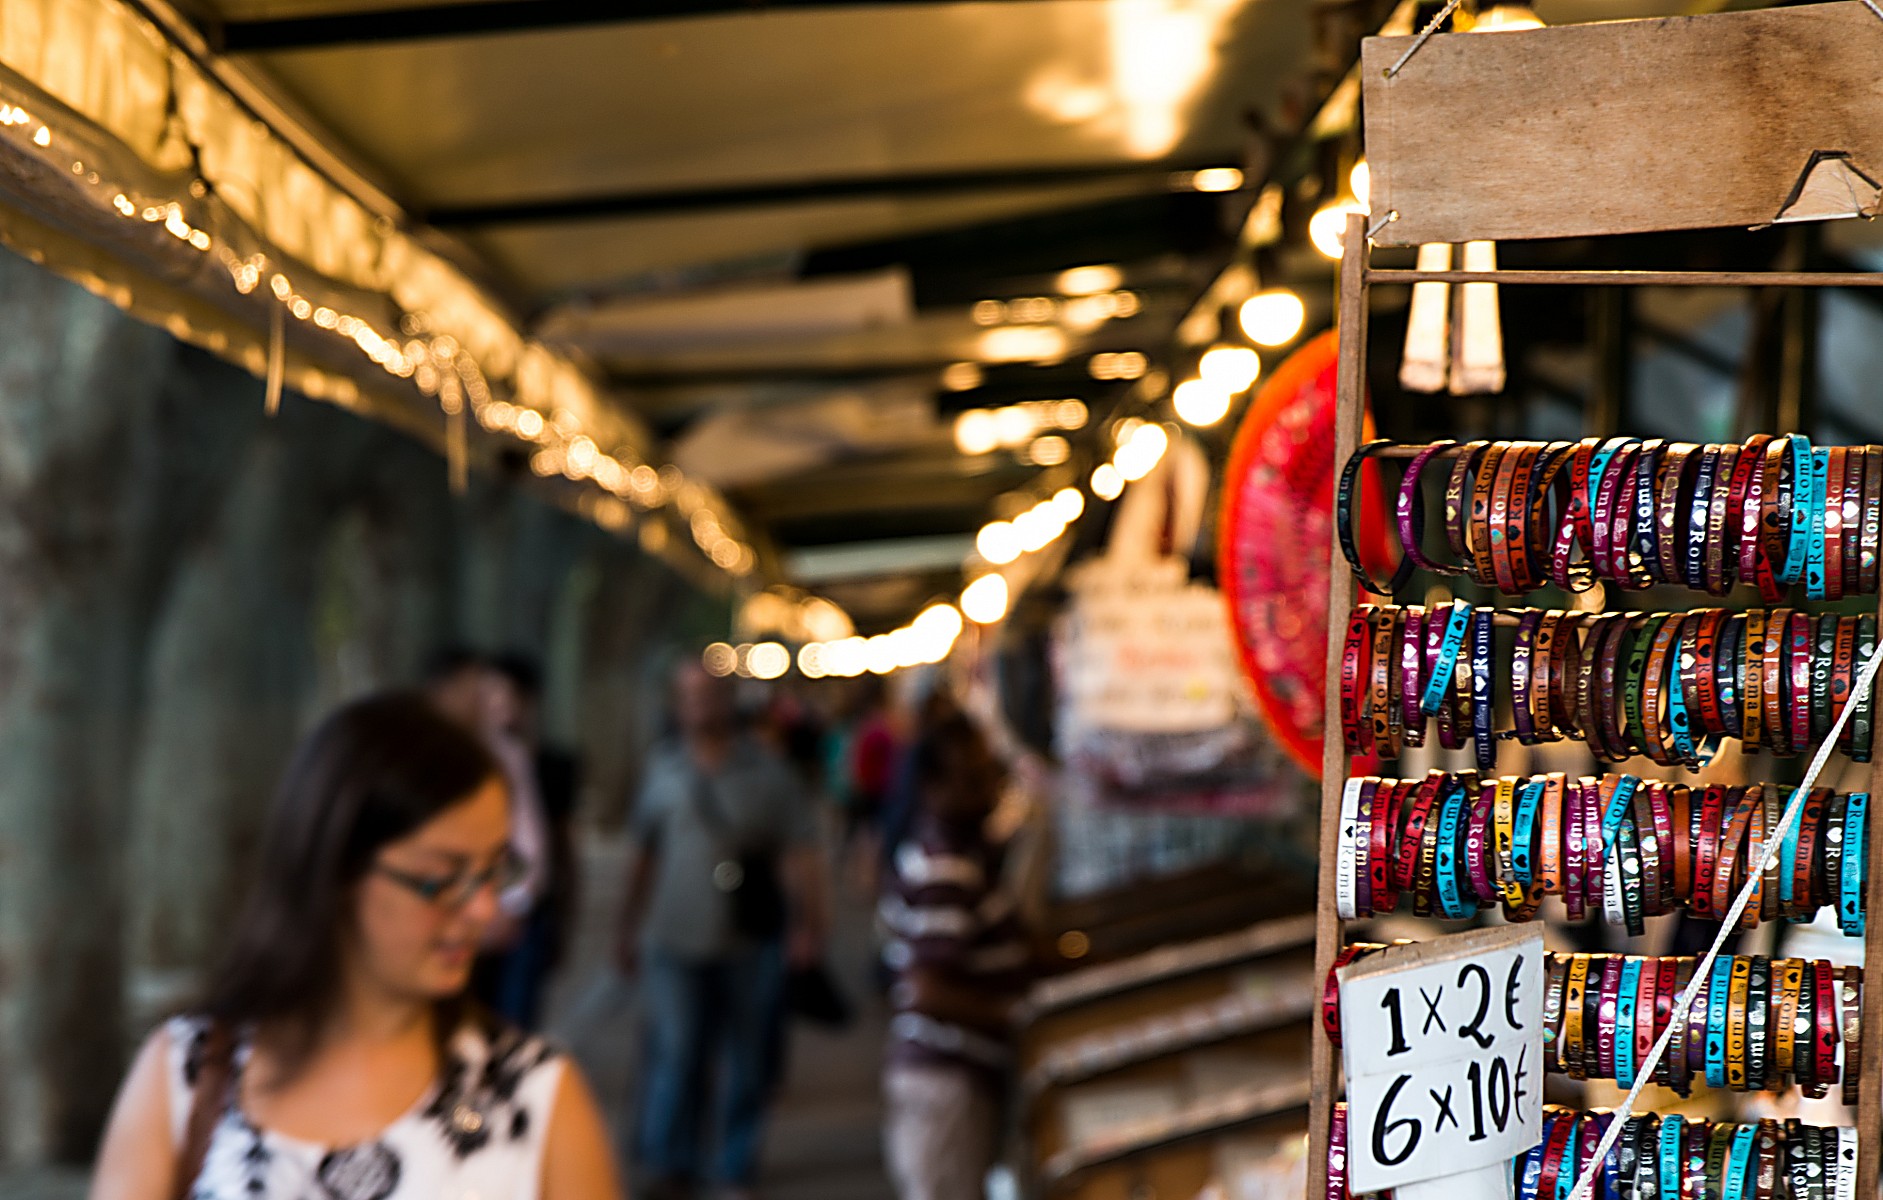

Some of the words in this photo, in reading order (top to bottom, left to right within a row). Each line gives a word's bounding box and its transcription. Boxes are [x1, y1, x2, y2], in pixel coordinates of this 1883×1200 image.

[1509, 472, 1527, 522] Roma
[1638, 476, 1650, 533] Roma
[1796, 454, 1809, 505] Roma
[1709, 486, 1730, 546] Roma
[1808, 508, 1824, 566] Roma
[1433, 635, 1463, 688] Roma
[1474, 619, 1489, 670] Roma
[1834, 629, 1852, 674] Roma
[1373, 659, 1388, 714] Roma
[1512, 646, 1530, 703] Roma
[1698, 663, 1712, 714] Roma
[1747, 659, 1763, 711] Roma
[1813, 657, 1831, 708] Roma
[1538, 684, 1549, 737] Roma
[1439, 797, 1460, 845] Roma
[1585, 785, 1600, 834] Roma
[1605, 787, 1633, 831] Roma
[1845, 809, 1862, 857] Roma
[1356, 822, 1371, 877] Roma
[1416, 834, 1437, 891] Roma
[1467, 823, 1484, 879] Roma
[1543, 818, 1557, 873] Roma
[1567, 812, 1583, 867] Roma
[1699, 838, 1715, 894] Roma
[1795, 822, 1817, 871] Roma
[1338, 845, 1355, 898] Roma
[1638, 976, 1654, 1028] Roma
[1709, 980, 1726, 1035] Roma
[1777, 988, 1797, 1044] Roma
[1616, 1024, 1631, 1080] Roma
[1729, 1009, 1745, 1064] Roma
[1750, 1030, 1766, 1080] Roma
